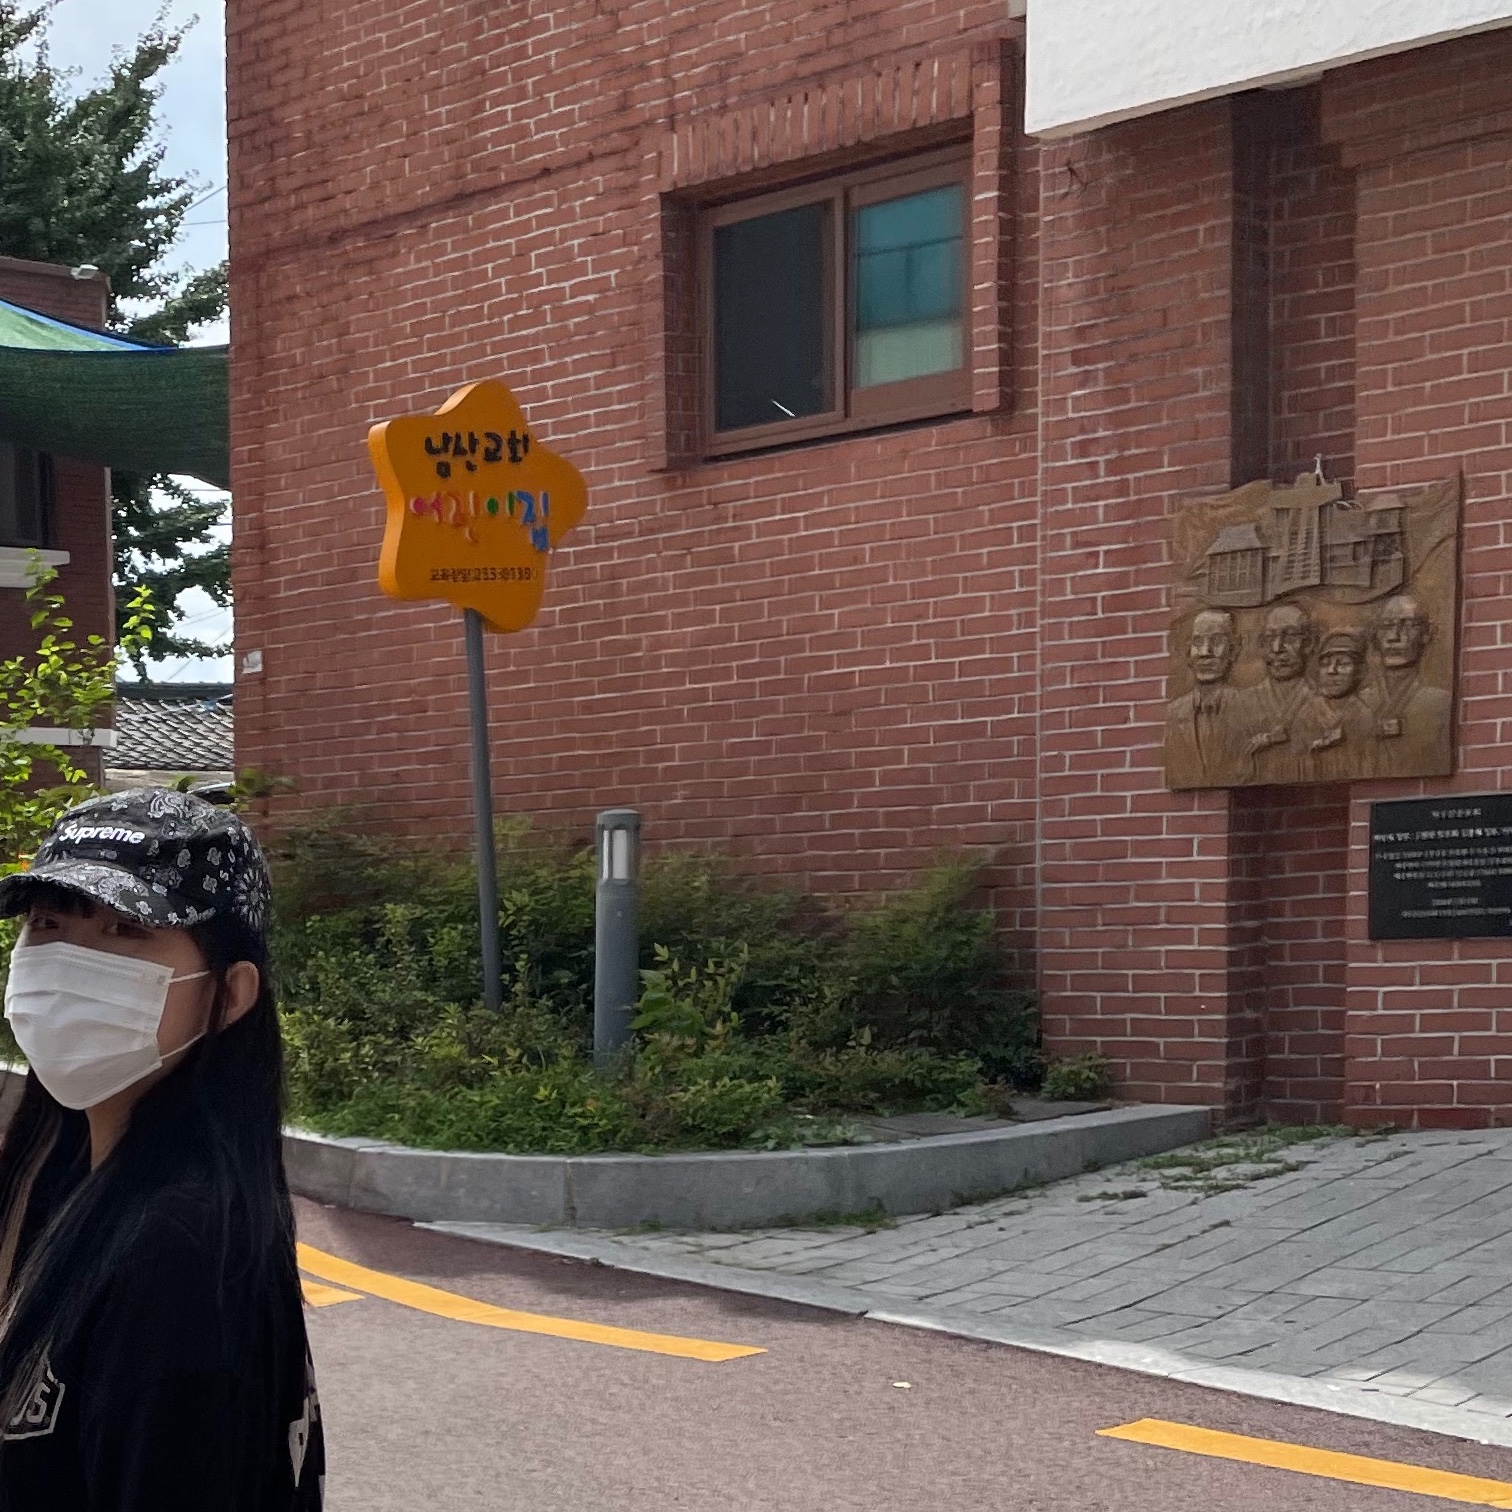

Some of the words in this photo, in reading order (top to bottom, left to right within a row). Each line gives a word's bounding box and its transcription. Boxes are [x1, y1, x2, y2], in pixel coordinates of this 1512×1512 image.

[425, 430, 529, 479] 남산교회
[409, 490, 550, 553] 어린이집
[58, 822, 146, 845] Supreme
